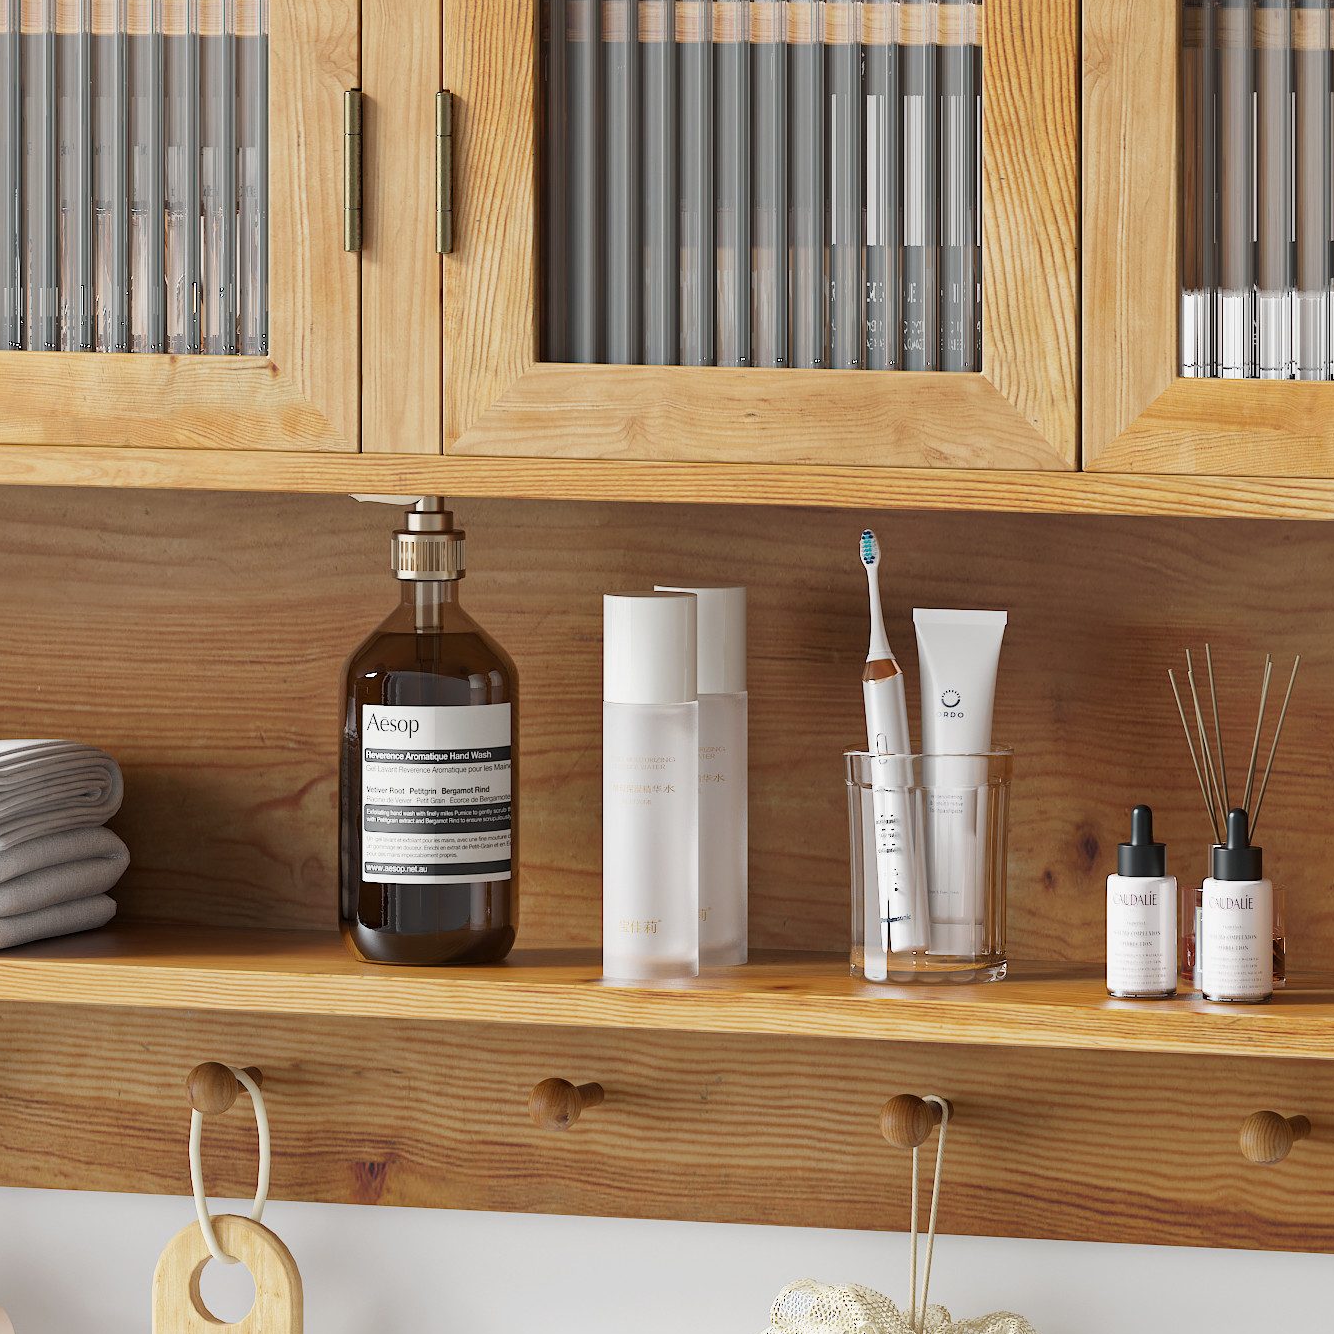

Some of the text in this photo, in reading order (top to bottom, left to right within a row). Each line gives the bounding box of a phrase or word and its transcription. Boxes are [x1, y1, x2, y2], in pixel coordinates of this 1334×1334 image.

[366, 750, 492, 762] Reverence Aromatique Hand Wash
[432, 766, 467, 775] Aromatique
[468, 766, 482, 774] pour
[441, 787, 474, 796] Bergamot
[475, 785, 490, 794] Rind
[366, 864, 428, 874] www.aesop.net.au
